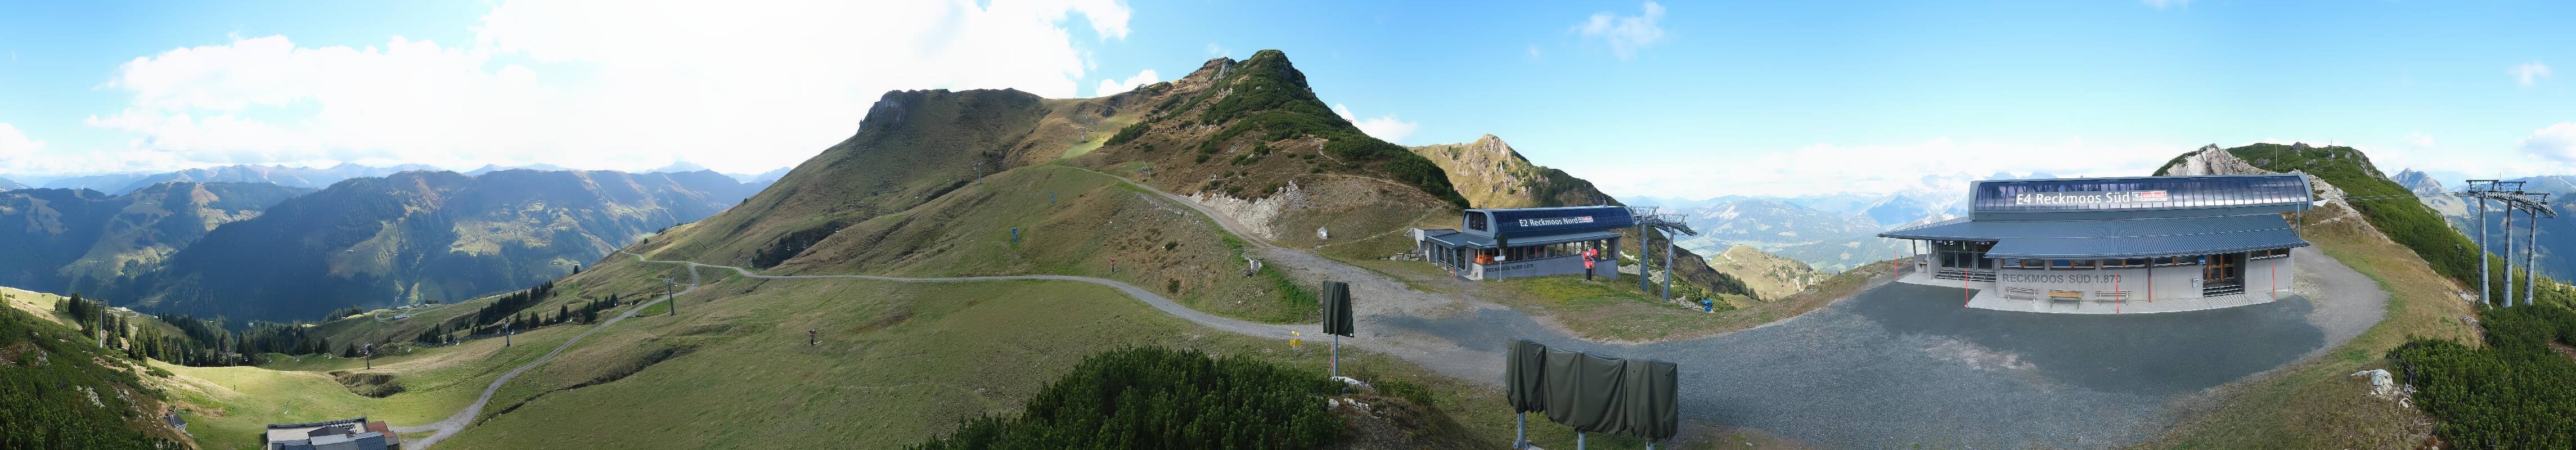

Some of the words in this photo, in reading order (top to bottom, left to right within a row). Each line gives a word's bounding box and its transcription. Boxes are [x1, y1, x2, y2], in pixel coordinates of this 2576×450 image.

[2016, 194, 2031, 205] E4
[2036, 192, 2101, 204] Reckmoos
[2106, 192, 2130, 203] Süd
[1563, 217, 1578, 225] Nord
[2002, 273, 2064, 284] RECKMOOS
[2069, 273, 2091, 284] SÜD
[2094, 274, 2121, 284] 1.870
